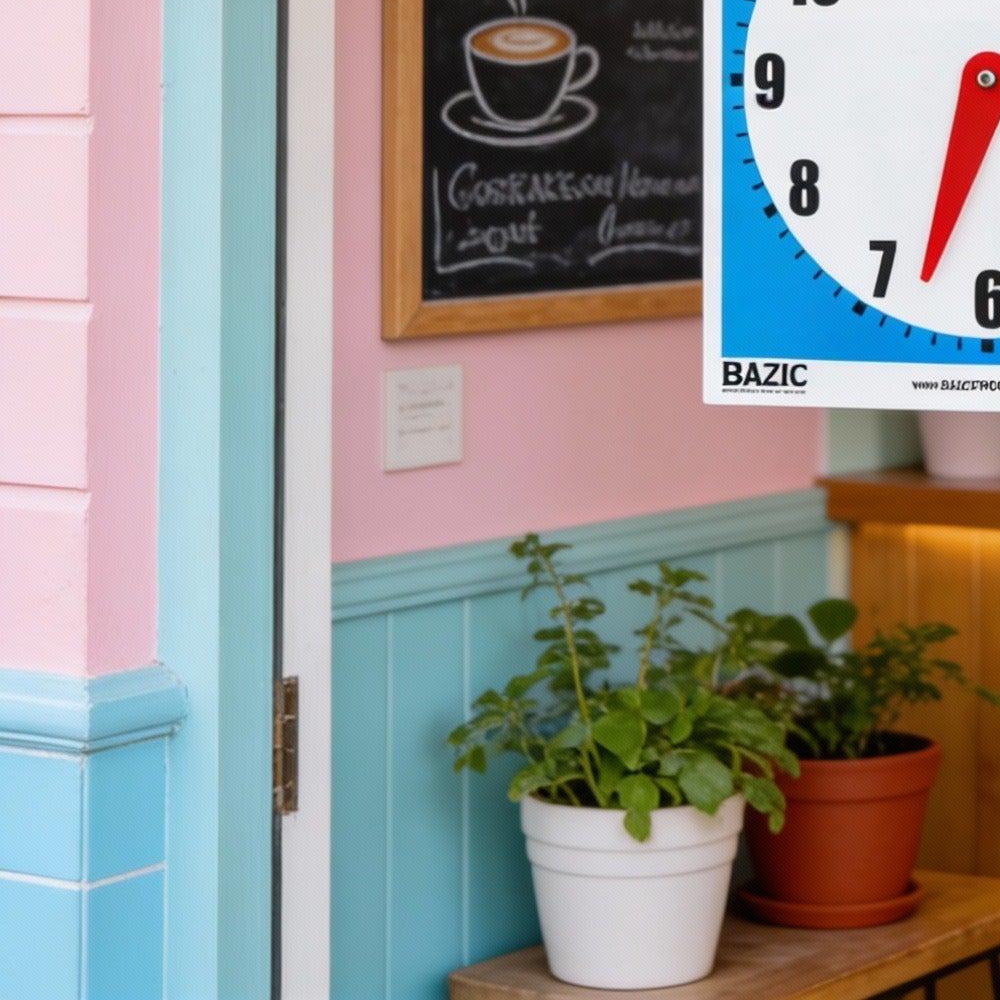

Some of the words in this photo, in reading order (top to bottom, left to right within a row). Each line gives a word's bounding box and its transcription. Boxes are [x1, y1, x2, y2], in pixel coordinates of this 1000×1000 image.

[753, 52, 786, 110] 9
[788, 158, 821, 217] 8
[868, 240, 898, 299] 7
[722, 361, 808, 387] BAZIC
